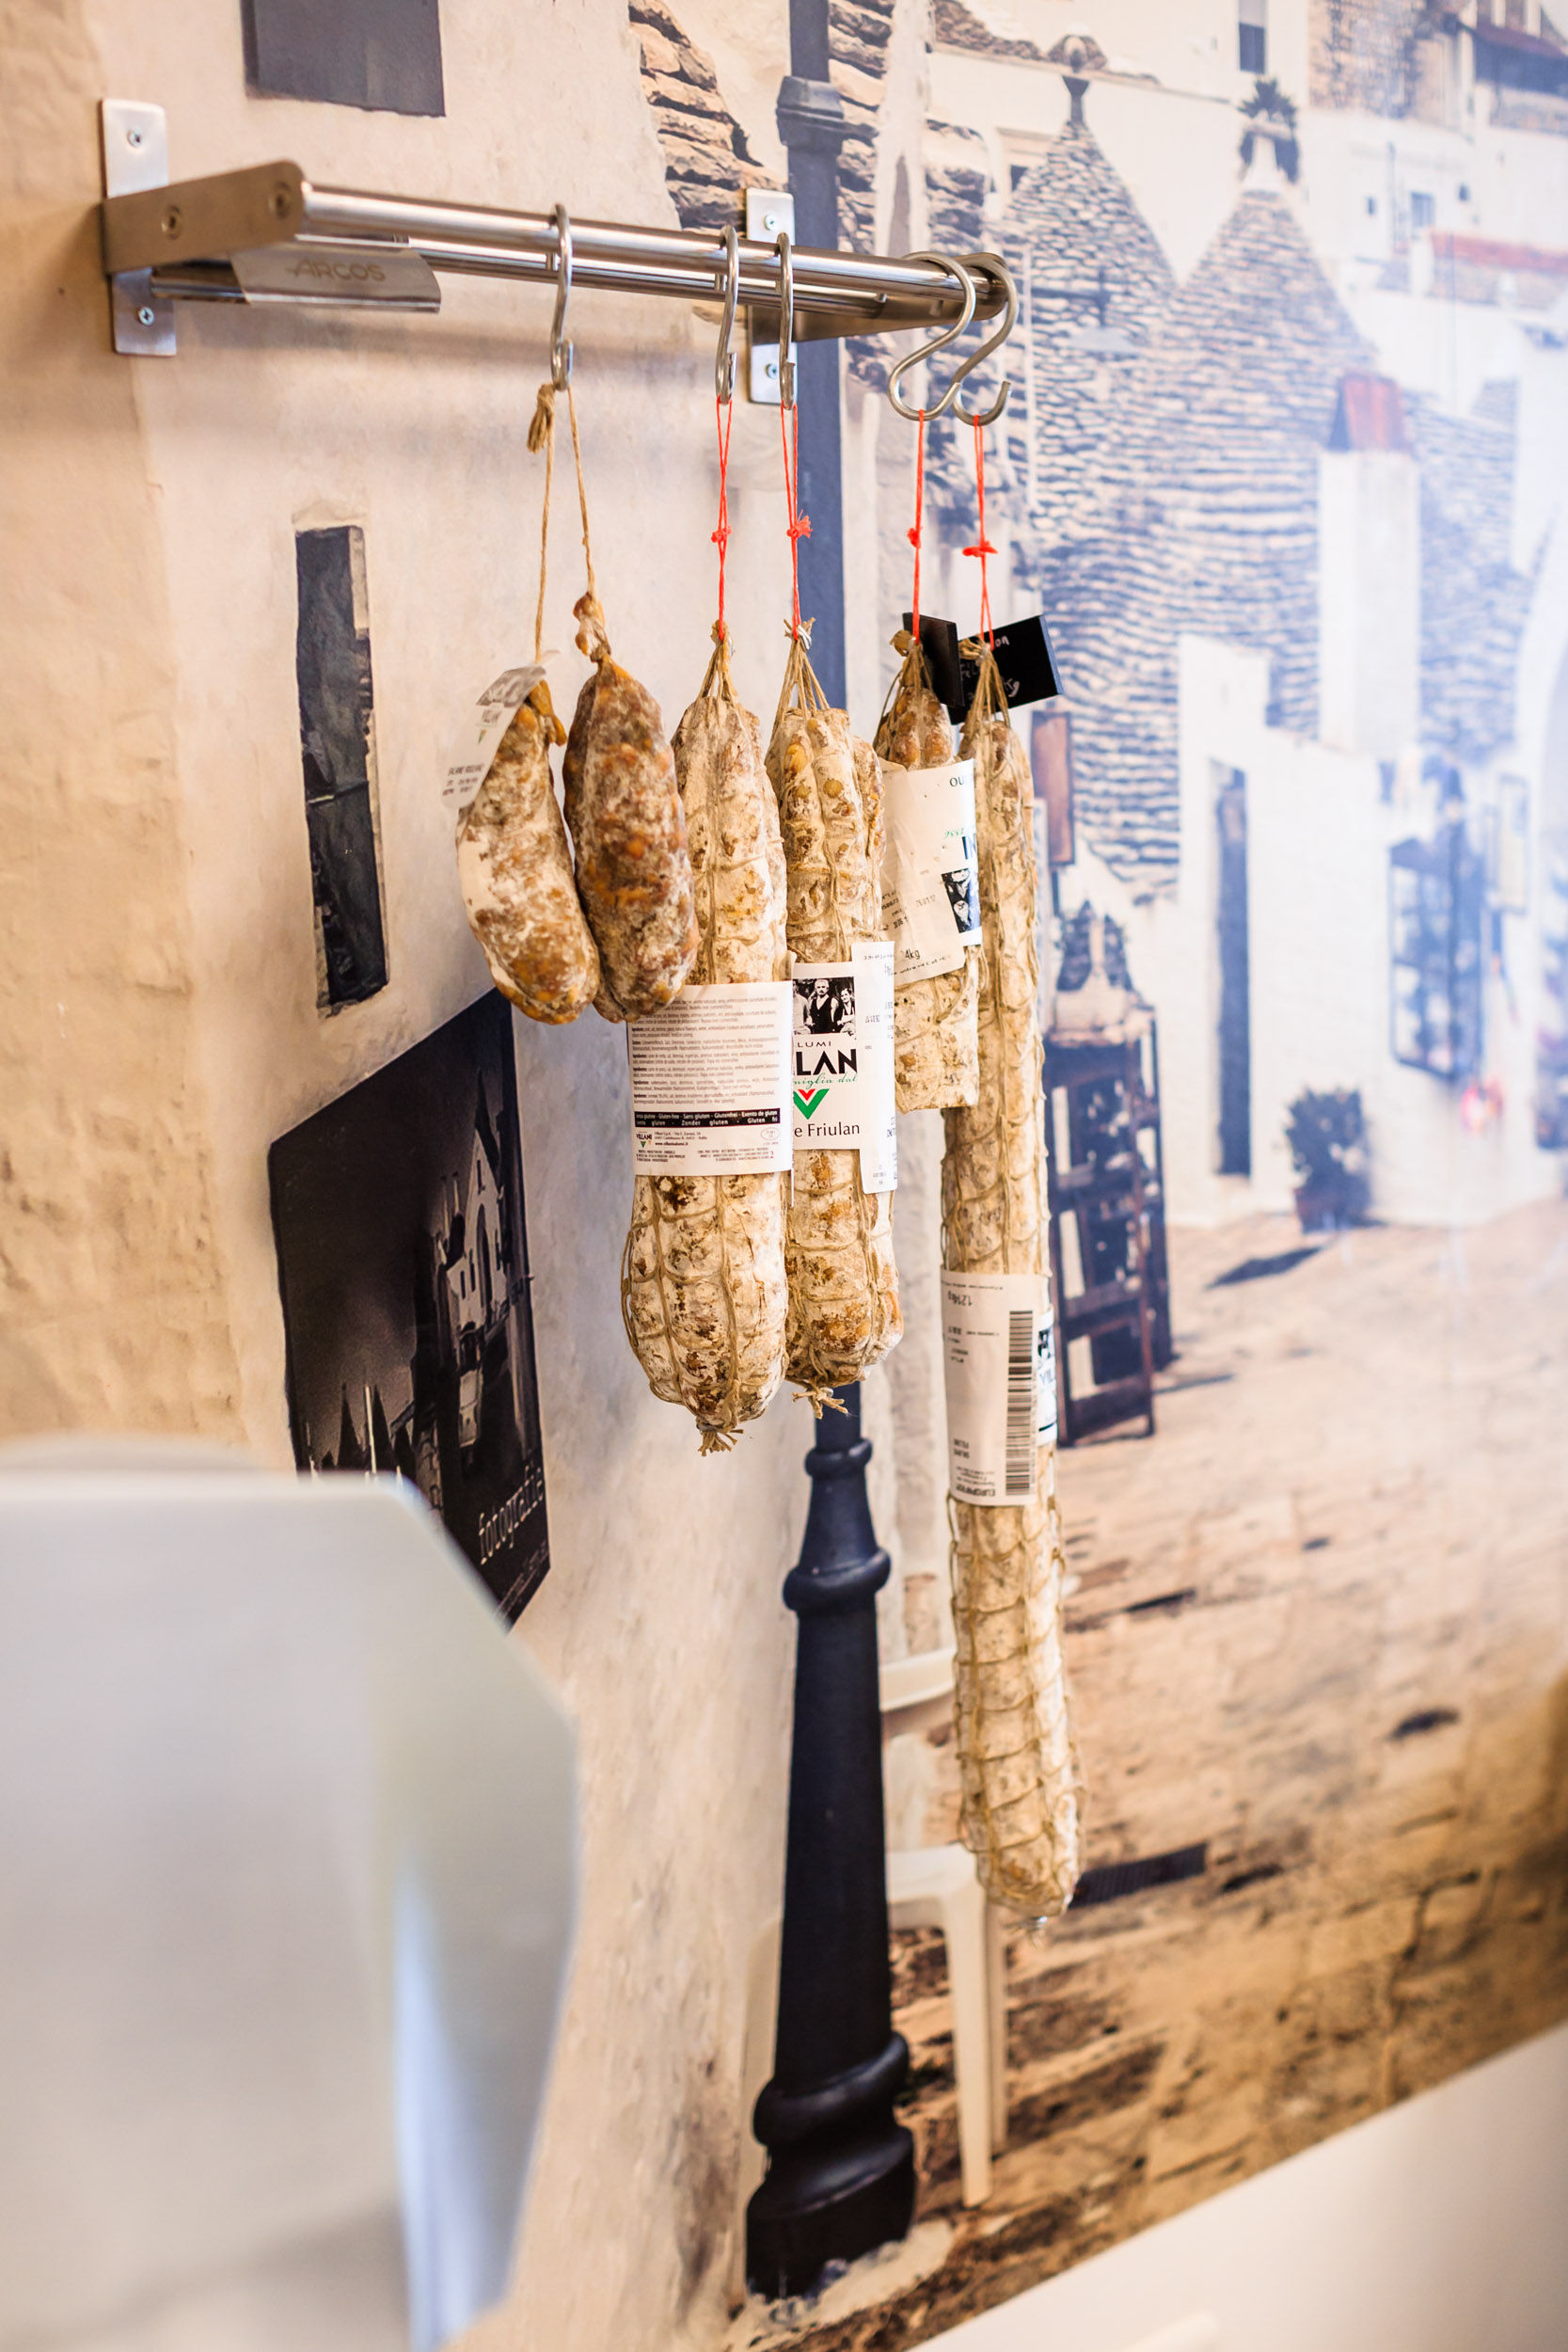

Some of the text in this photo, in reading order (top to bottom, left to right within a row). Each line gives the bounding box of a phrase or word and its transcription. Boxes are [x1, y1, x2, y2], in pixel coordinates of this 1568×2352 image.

[286, 257, 387, 282] ARCOS
[795, 1048, 858, 1076] LAN
[709, 1119, 728, 1127] gluten
[807, 1121, 861, 1137] Friulan
